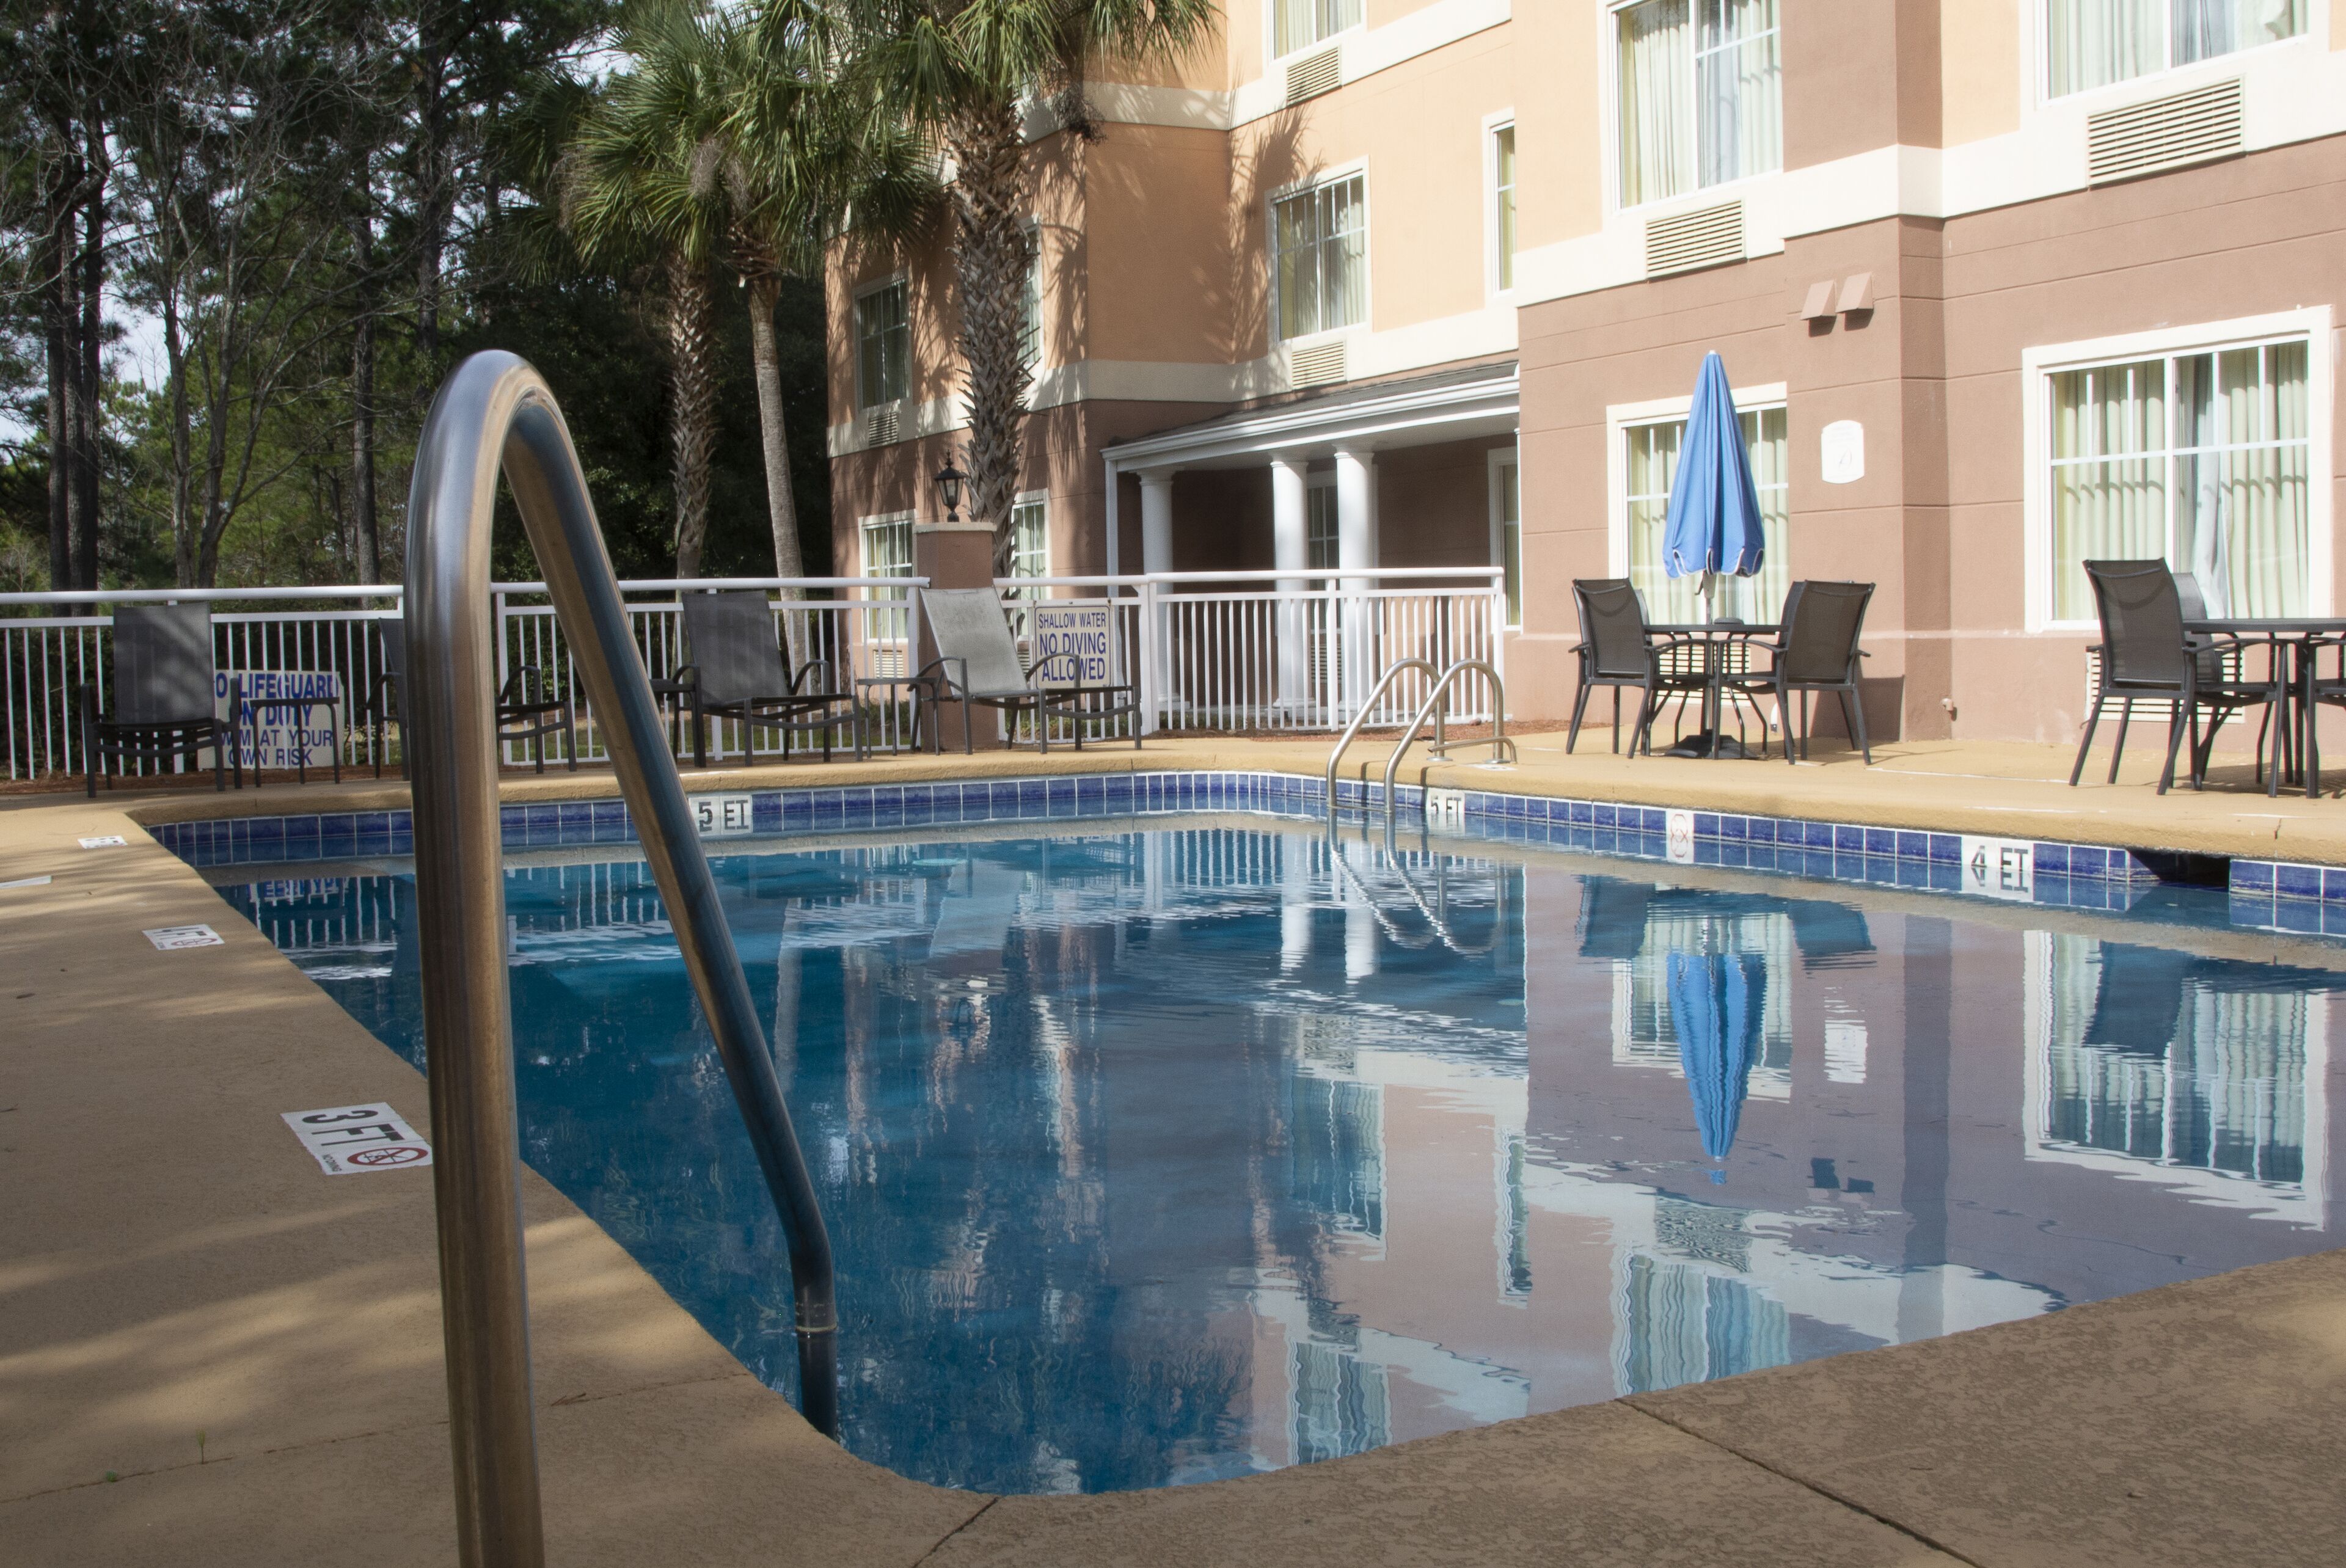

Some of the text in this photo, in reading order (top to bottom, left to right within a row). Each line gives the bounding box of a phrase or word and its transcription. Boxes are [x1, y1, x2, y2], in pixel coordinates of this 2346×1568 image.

[1039, 613, 1106, 629] SHALLOW WATER
[1040, 632, 1106, 655] NO DIVING
[1042, 658, 1105, 682] ALLOWED
[216, 673, 339, 699] O LIFEGUARD
[241, 701, 254, 726] N
[221, 729, 333, 746] WM AT YOUR
[276, 748, 313, 766] RISK
[302, 1110, 405, 1147] 3 FT
